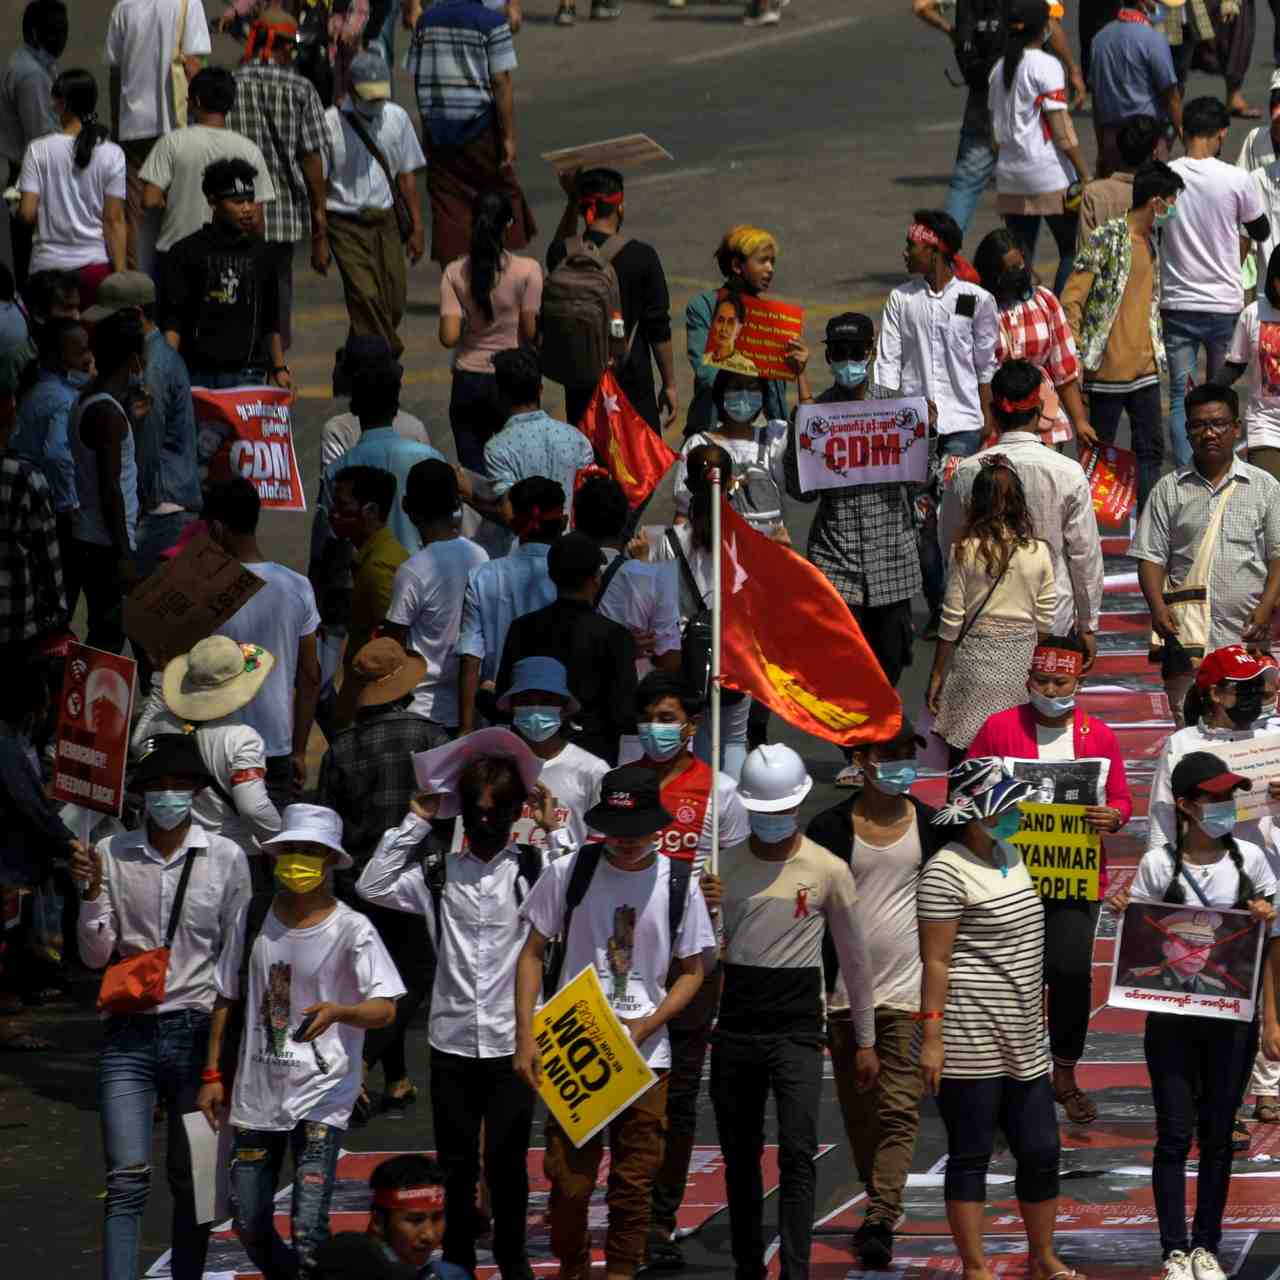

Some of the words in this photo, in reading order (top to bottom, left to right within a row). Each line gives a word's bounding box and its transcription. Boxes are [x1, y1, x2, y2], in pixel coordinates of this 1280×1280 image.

[825, 433, 900, 471] CDM
[1020, 842, 1097, 879] YANMAR
[1031, 876, 1088, 899] EOPLE
